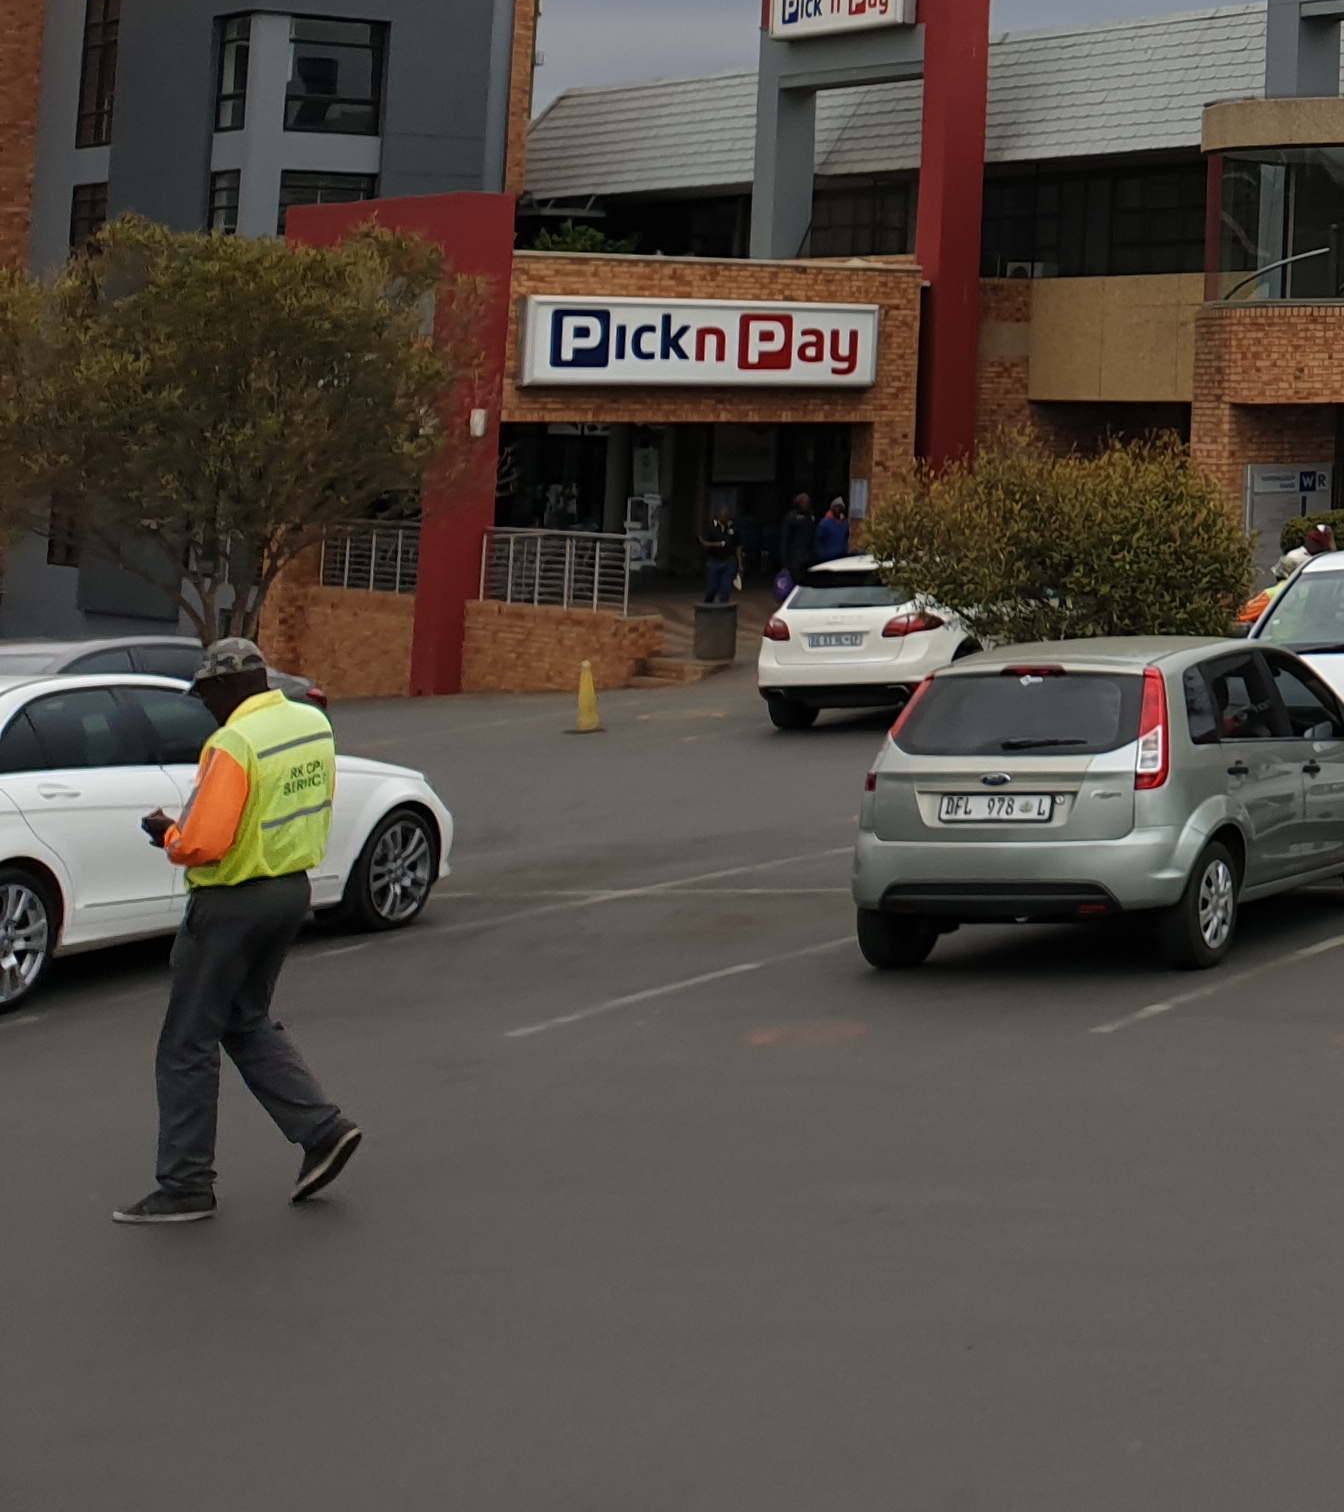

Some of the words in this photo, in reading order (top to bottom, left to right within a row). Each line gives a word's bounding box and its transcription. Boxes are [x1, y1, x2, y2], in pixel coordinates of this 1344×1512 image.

[554, 312, 691, 365] Pick
[694, 326, 726, 363] n
[741, 315, 859, 375] Pay
[945, 796, 972, 816] DFL
[987, 797, 1015, 817] 978
[1037, 798, 1046, 817] L
